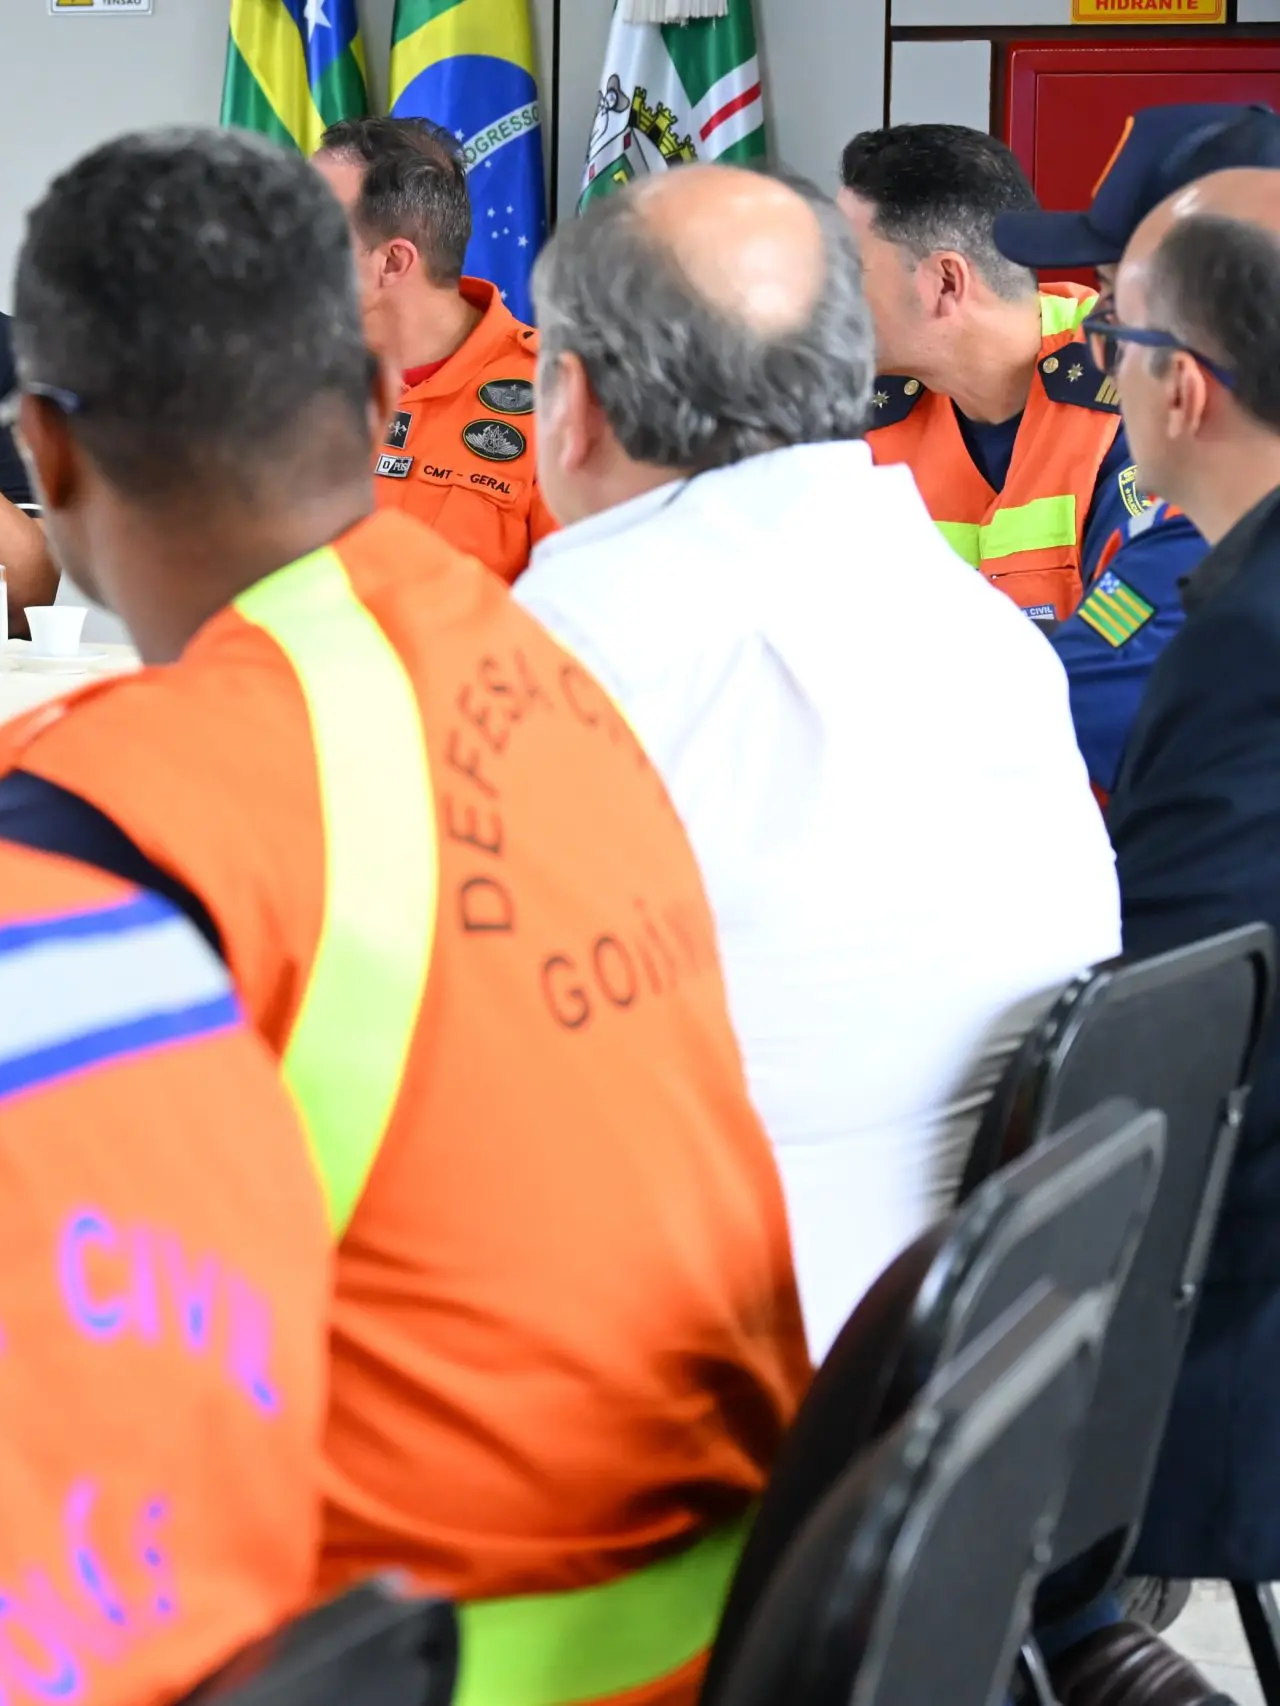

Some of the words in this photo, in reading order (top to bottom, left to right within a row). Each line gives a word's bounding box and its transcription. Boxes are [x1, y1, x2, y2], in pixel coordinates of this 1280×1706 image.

[1095, 0, 1199, 10] HIDRANTE
[463, 105, 539, 164] OGRESSO
[423, 465, 453, 480] CMT
[469, 473, 511, 494] GERAL
